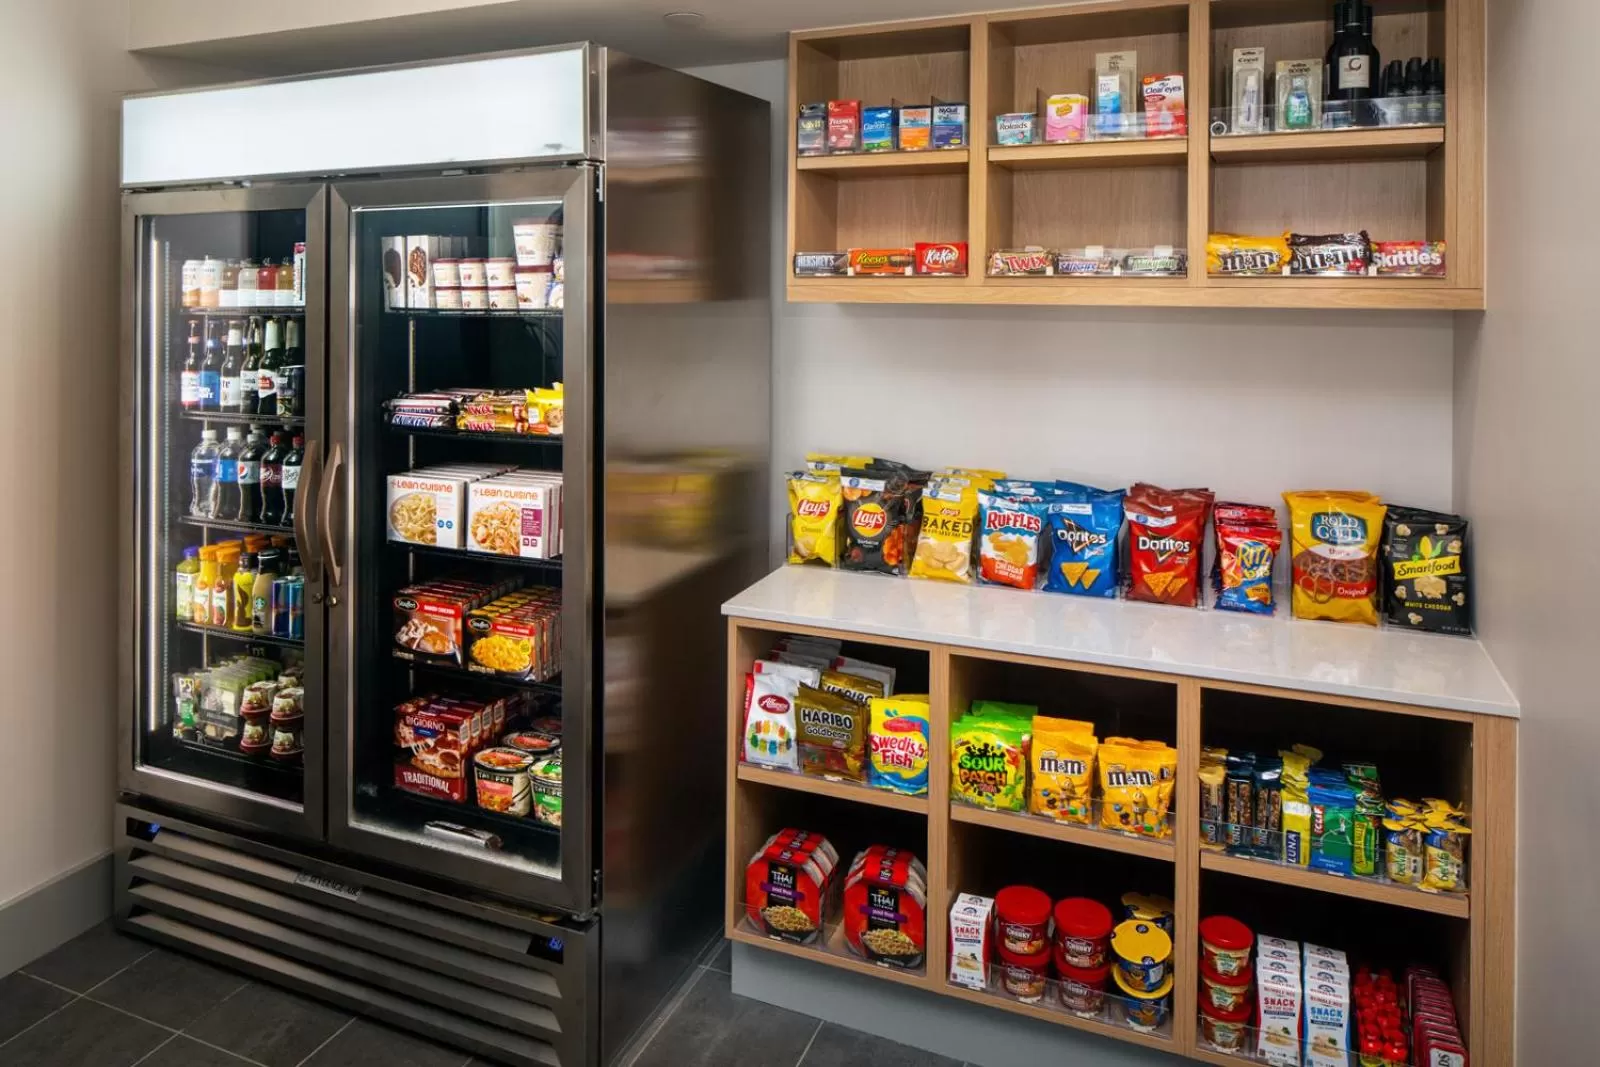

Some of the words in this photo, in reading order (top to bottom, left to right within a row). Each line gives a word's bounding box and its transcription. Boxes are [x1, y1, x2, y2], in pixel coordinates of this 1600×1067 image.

[854, 510, 885, 529] Lay's
[922, 515, 973, 534] BAKED
[986, 509, 1042, 533] RUFFLES
[1321, 514, 1360, 529] ROLD
[1138, 535, 1191, 553] Doritos
[1397, 558, 1457, 578] Smartfood
[801, 708, 853, 730] HARIBO
[869, 734, 926, 758] Swedish
[879, 748, 914, 769] Fish
[960, 755, 1004, 772] SOUR
[402, 771, 451, 793] TRADITIONAL
[1287, 832, 1298, 863] LUNA
[771, 869, 793, 885] THAI
[871, 892, 895, 907] THAI
[1263, 996, 1296, 1009] SNACK
[1310, 1006, 1343, 1019] SNACK
